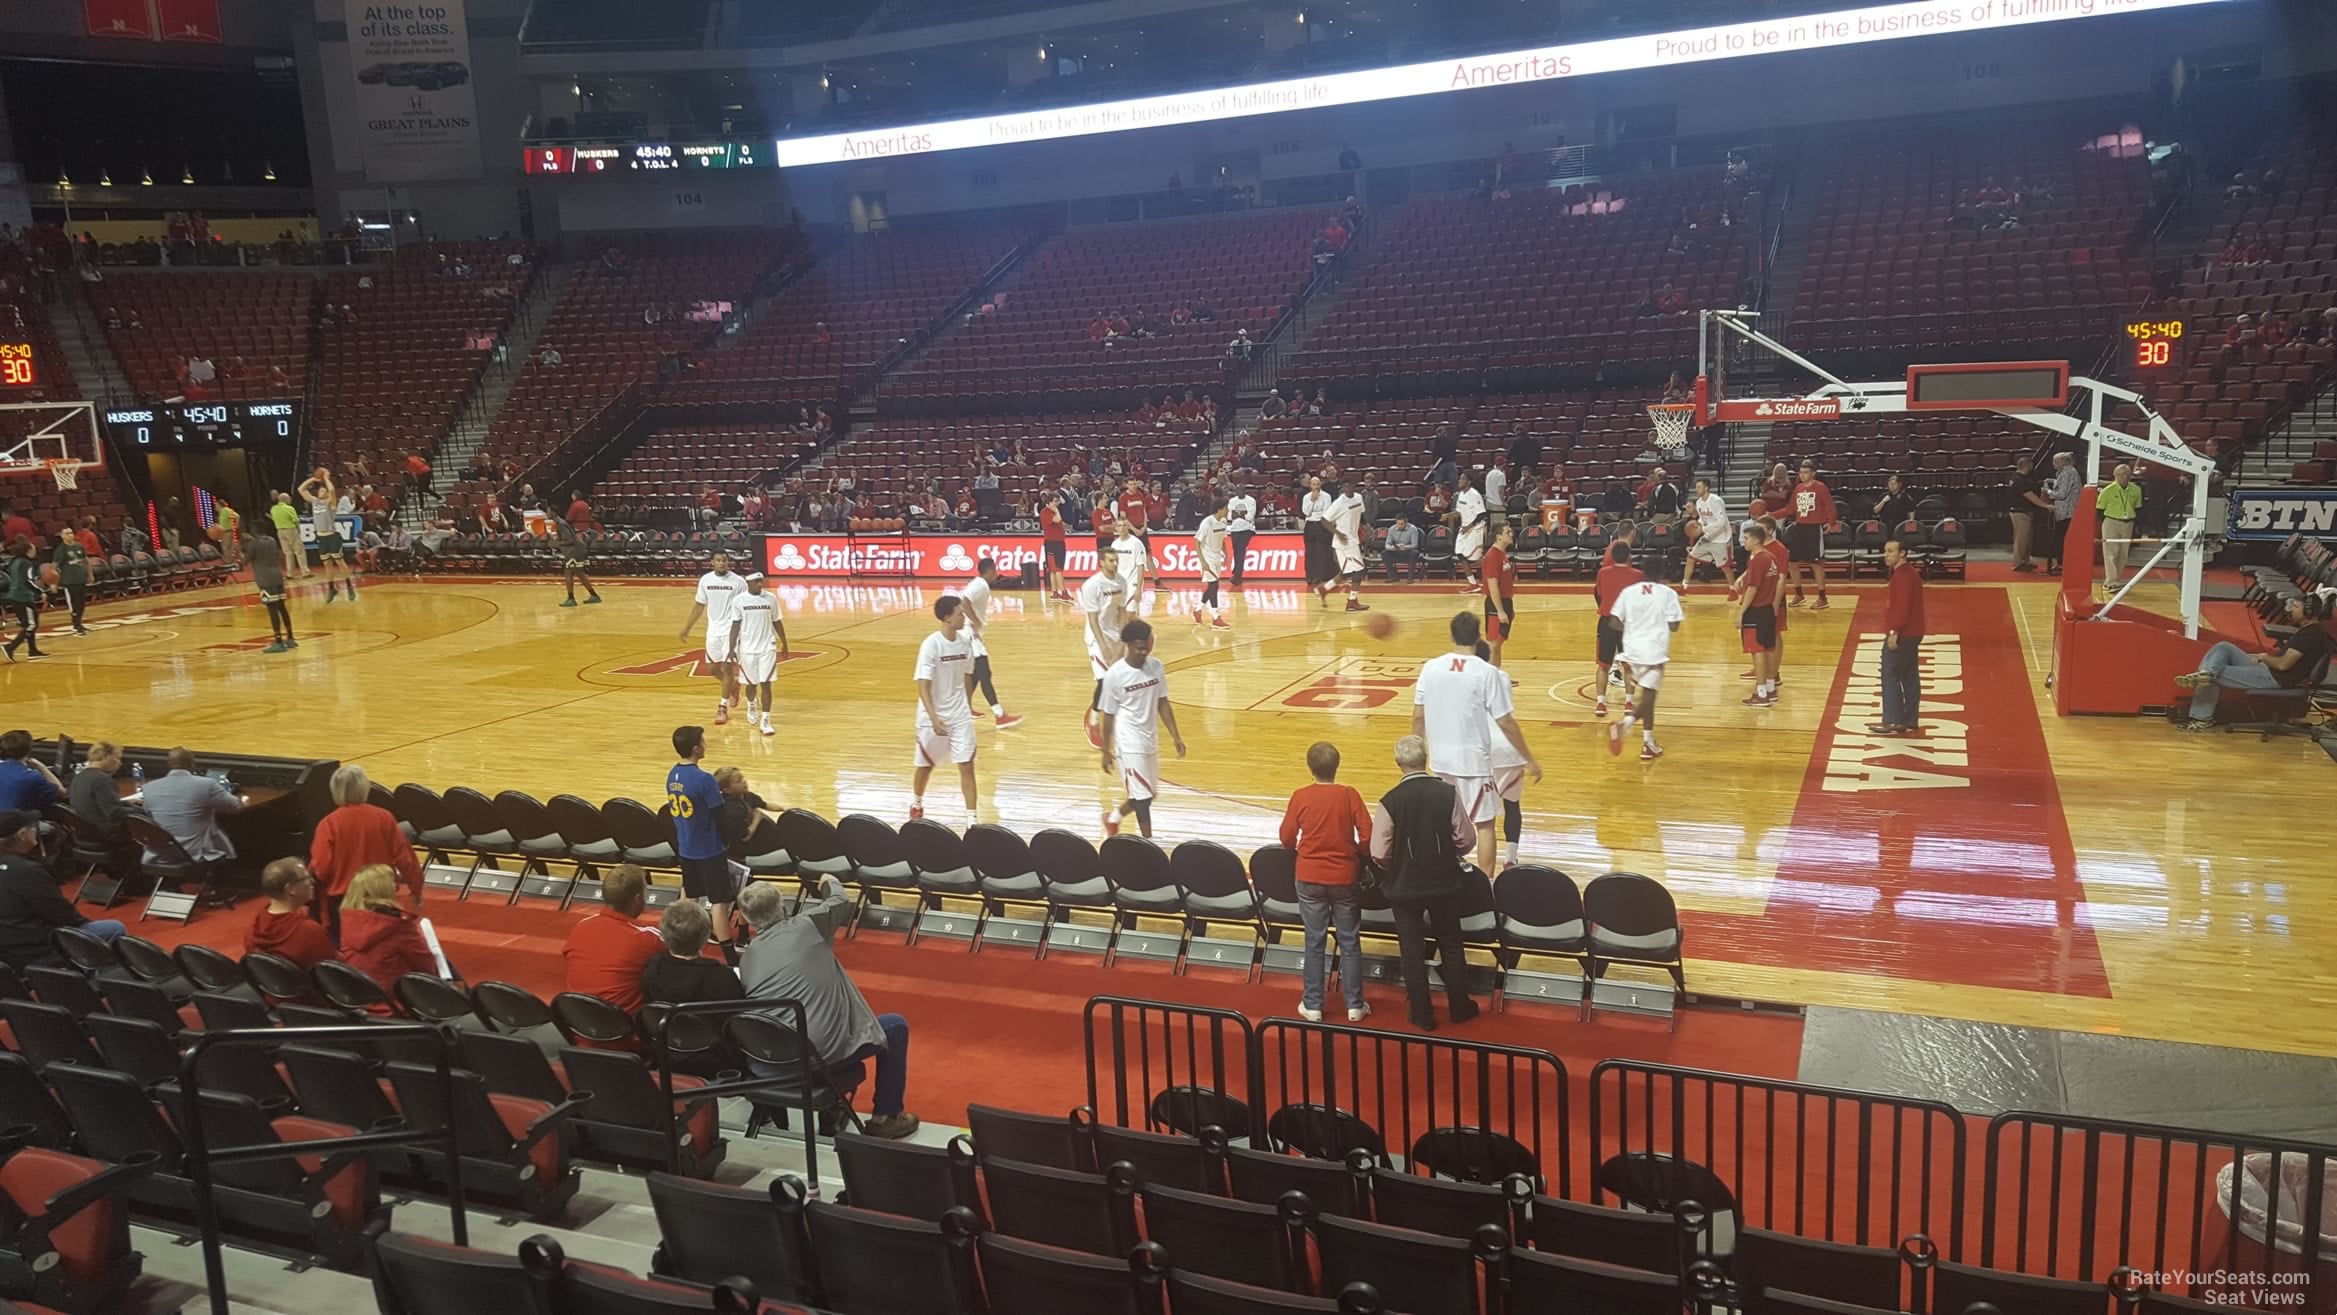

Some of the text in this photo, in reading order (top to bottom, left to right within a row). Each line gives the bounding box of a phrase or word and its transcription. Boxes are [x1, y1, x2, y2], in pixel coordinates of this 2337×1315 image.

[365, 4, 446, 22] At the top
[360, 20, 455, 37] of its class.
[1656, 34, 1717, 57] Proud
[1726, 32, 1744, 50] to
[1752, 28, 1779, 47] be
[1788, 24, 1806, 42] in
[1815, 20, 1849, 39] the
[1858, 9, 1962, 35] business
[1970, 0, 1993, 22] of
[1451, 55, 1572, 87] Ameritas
[1102, 108, 1128, 124] the
[1131, 100, 1205, 121] business
[1211, 95, 1226, 113] of
[1232, 88, 1298, 108] fulfilling
[1303, 82, 1328, 101] life
[368, 117, 471, 130] GREAT PLAINS
[636, 146, 672, 158] 45:40
[683, 146, 725, 156] HORNETS
[741, 145, 750, 155] 0
[842, 132, 932, 158] Ameritas
[545, 150, 554, 160] 0
[576, 149, 619, 159] HUSKERS
[701, 156, 710, 167] 0
[595, 160, 605, 170] 0
[2127, 321, 2183, 339] 45:40
[2139, 341, 2169, 365] 30
[3, 359, 32, 383] 30
[107, 411, 154, 423] HUSKERS
[184, 406, 227, 422] 45:40
[250, 404, 293, 416] HORNETS
[138, 427, 149, 443] 0
[277, 420, 288, 436] 0
[2159, 451, 2193, 467] Sports
[2236, 500, 2337, 530] BTN
[300, 521, 353, 542] BN
[1641, 584, 1653, 595] N
[1449, 658, 1467, 672] N
[668, 793, 694, 818] 30
[1539, 985, 1546, 994] 2
